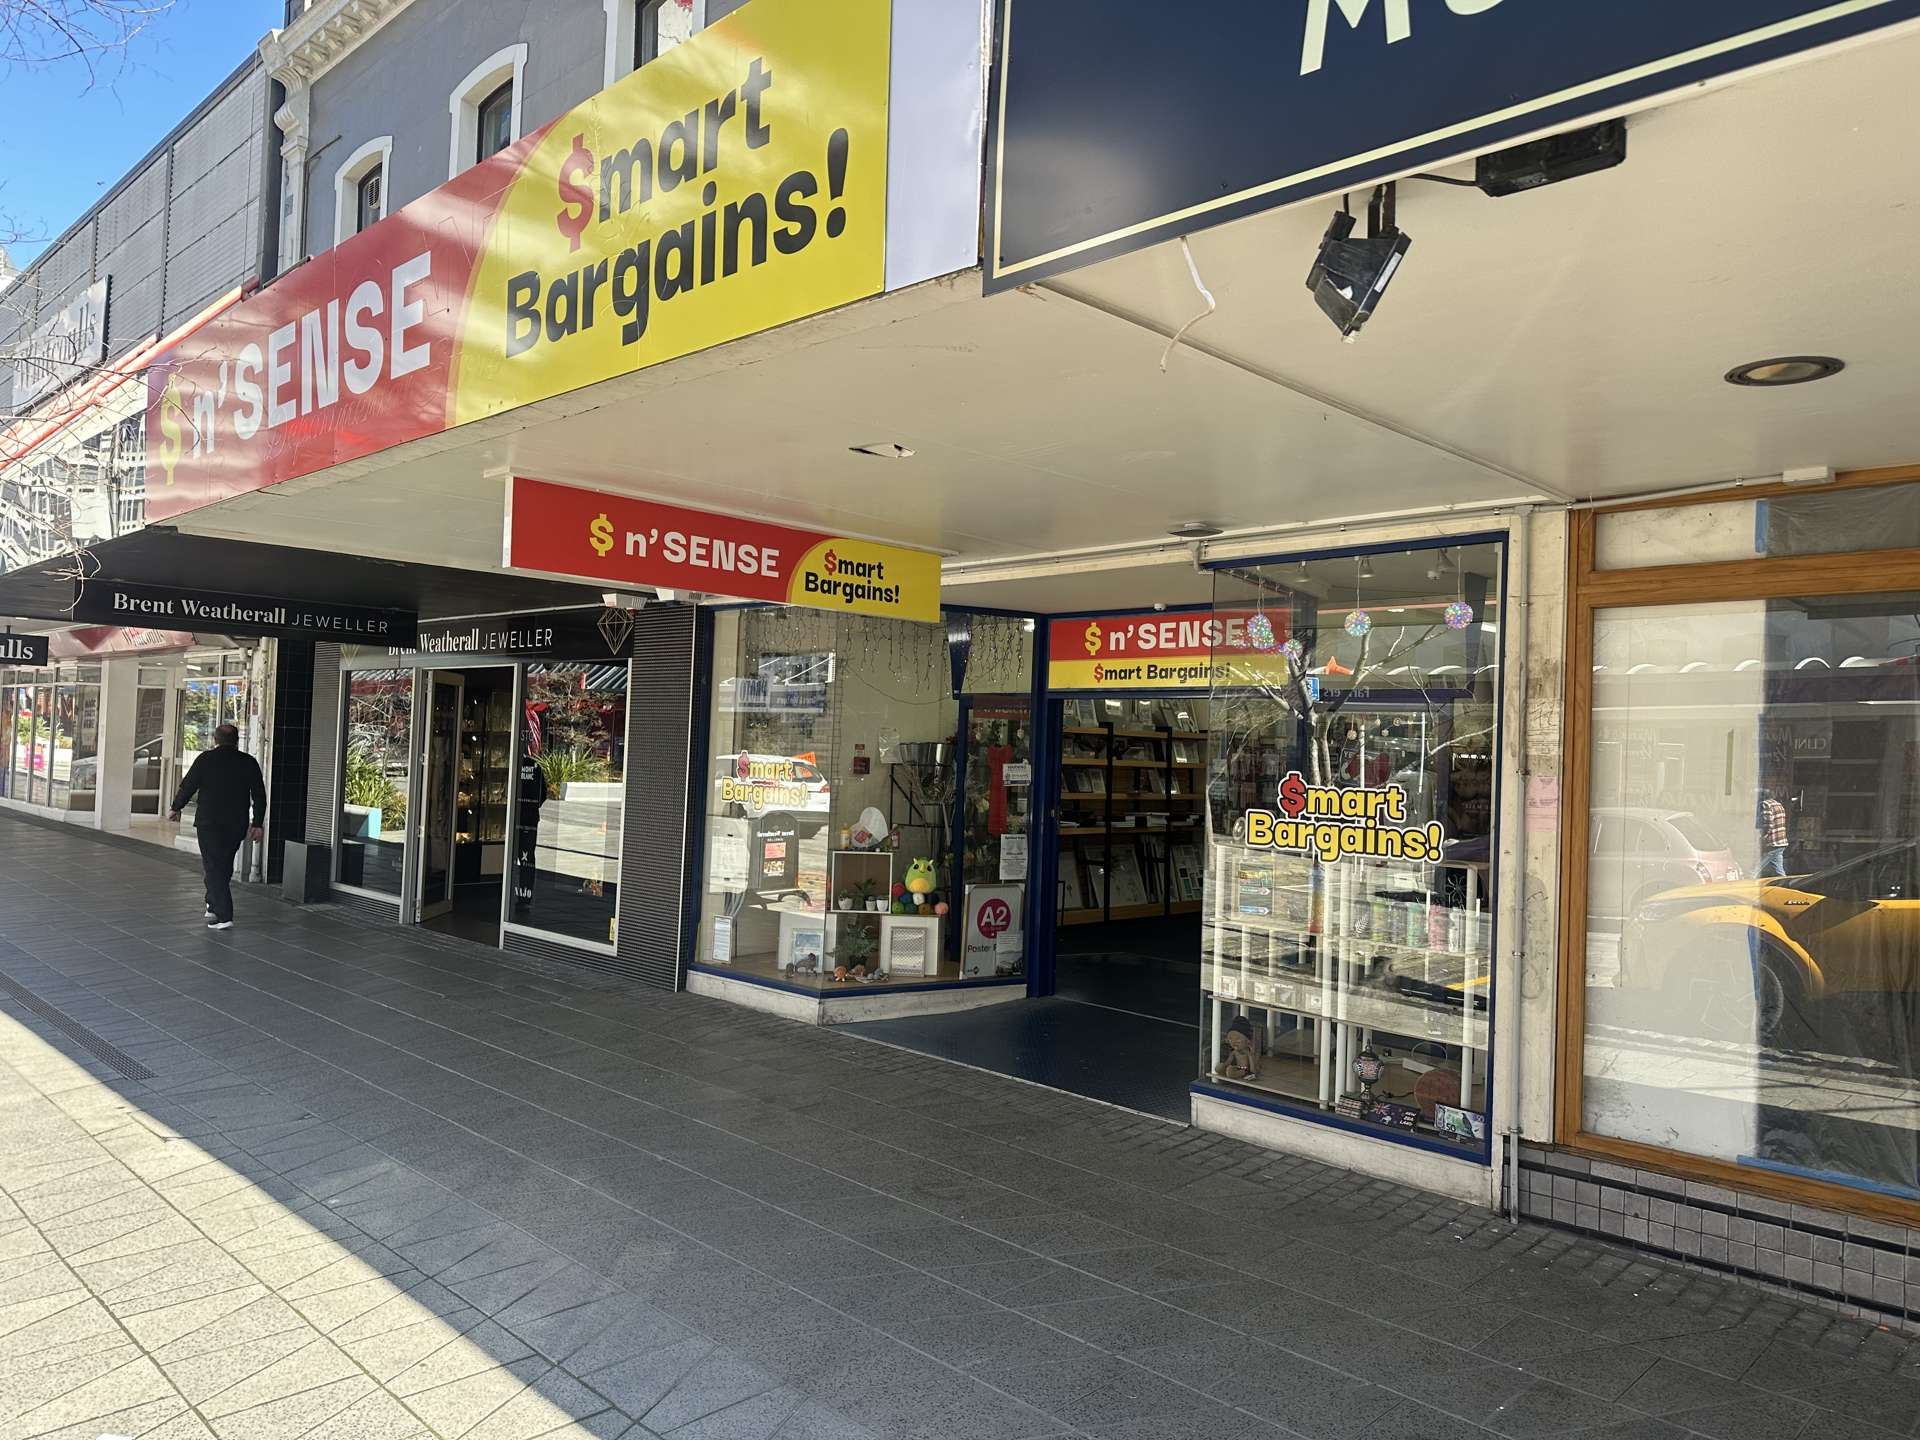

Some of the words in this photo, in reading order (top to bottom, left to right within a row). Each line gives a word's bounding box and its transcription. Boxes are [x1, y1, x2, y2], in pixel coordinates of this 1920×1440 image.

[556, 56, 772, 252] $mart
[506, 127, 850, 359] Bargains!
[590, 513, 615, 557] $
[625, 527, 781, 579] n'SENSE
[824, 548, 884, 580] $mart
[805, 571, 900, 604] Bargains!
[113, 592, 175, 615] Brent
[181, 599, 286, 625] Weatherall
[291, 614, 389, 633] JEWELLER
[419, 628, 480, 653] Weatherall
[482, 628, 553, 650] JEWELLER
[1084, 622, 1102, 656] $
[1093, 663, 1142, 683] $mart
[1147, 662, 1231, 683] Bargains!
[737, 750, 794, 781] $mart
[722, 776, 808, 811] Bargains!
[1278, 771, 1406, 822] $mart
[1246, 808, 1445, 864] Bargains!
[980, 905, 1008, 927] A2
[967, 943, 994, 953] Poster
